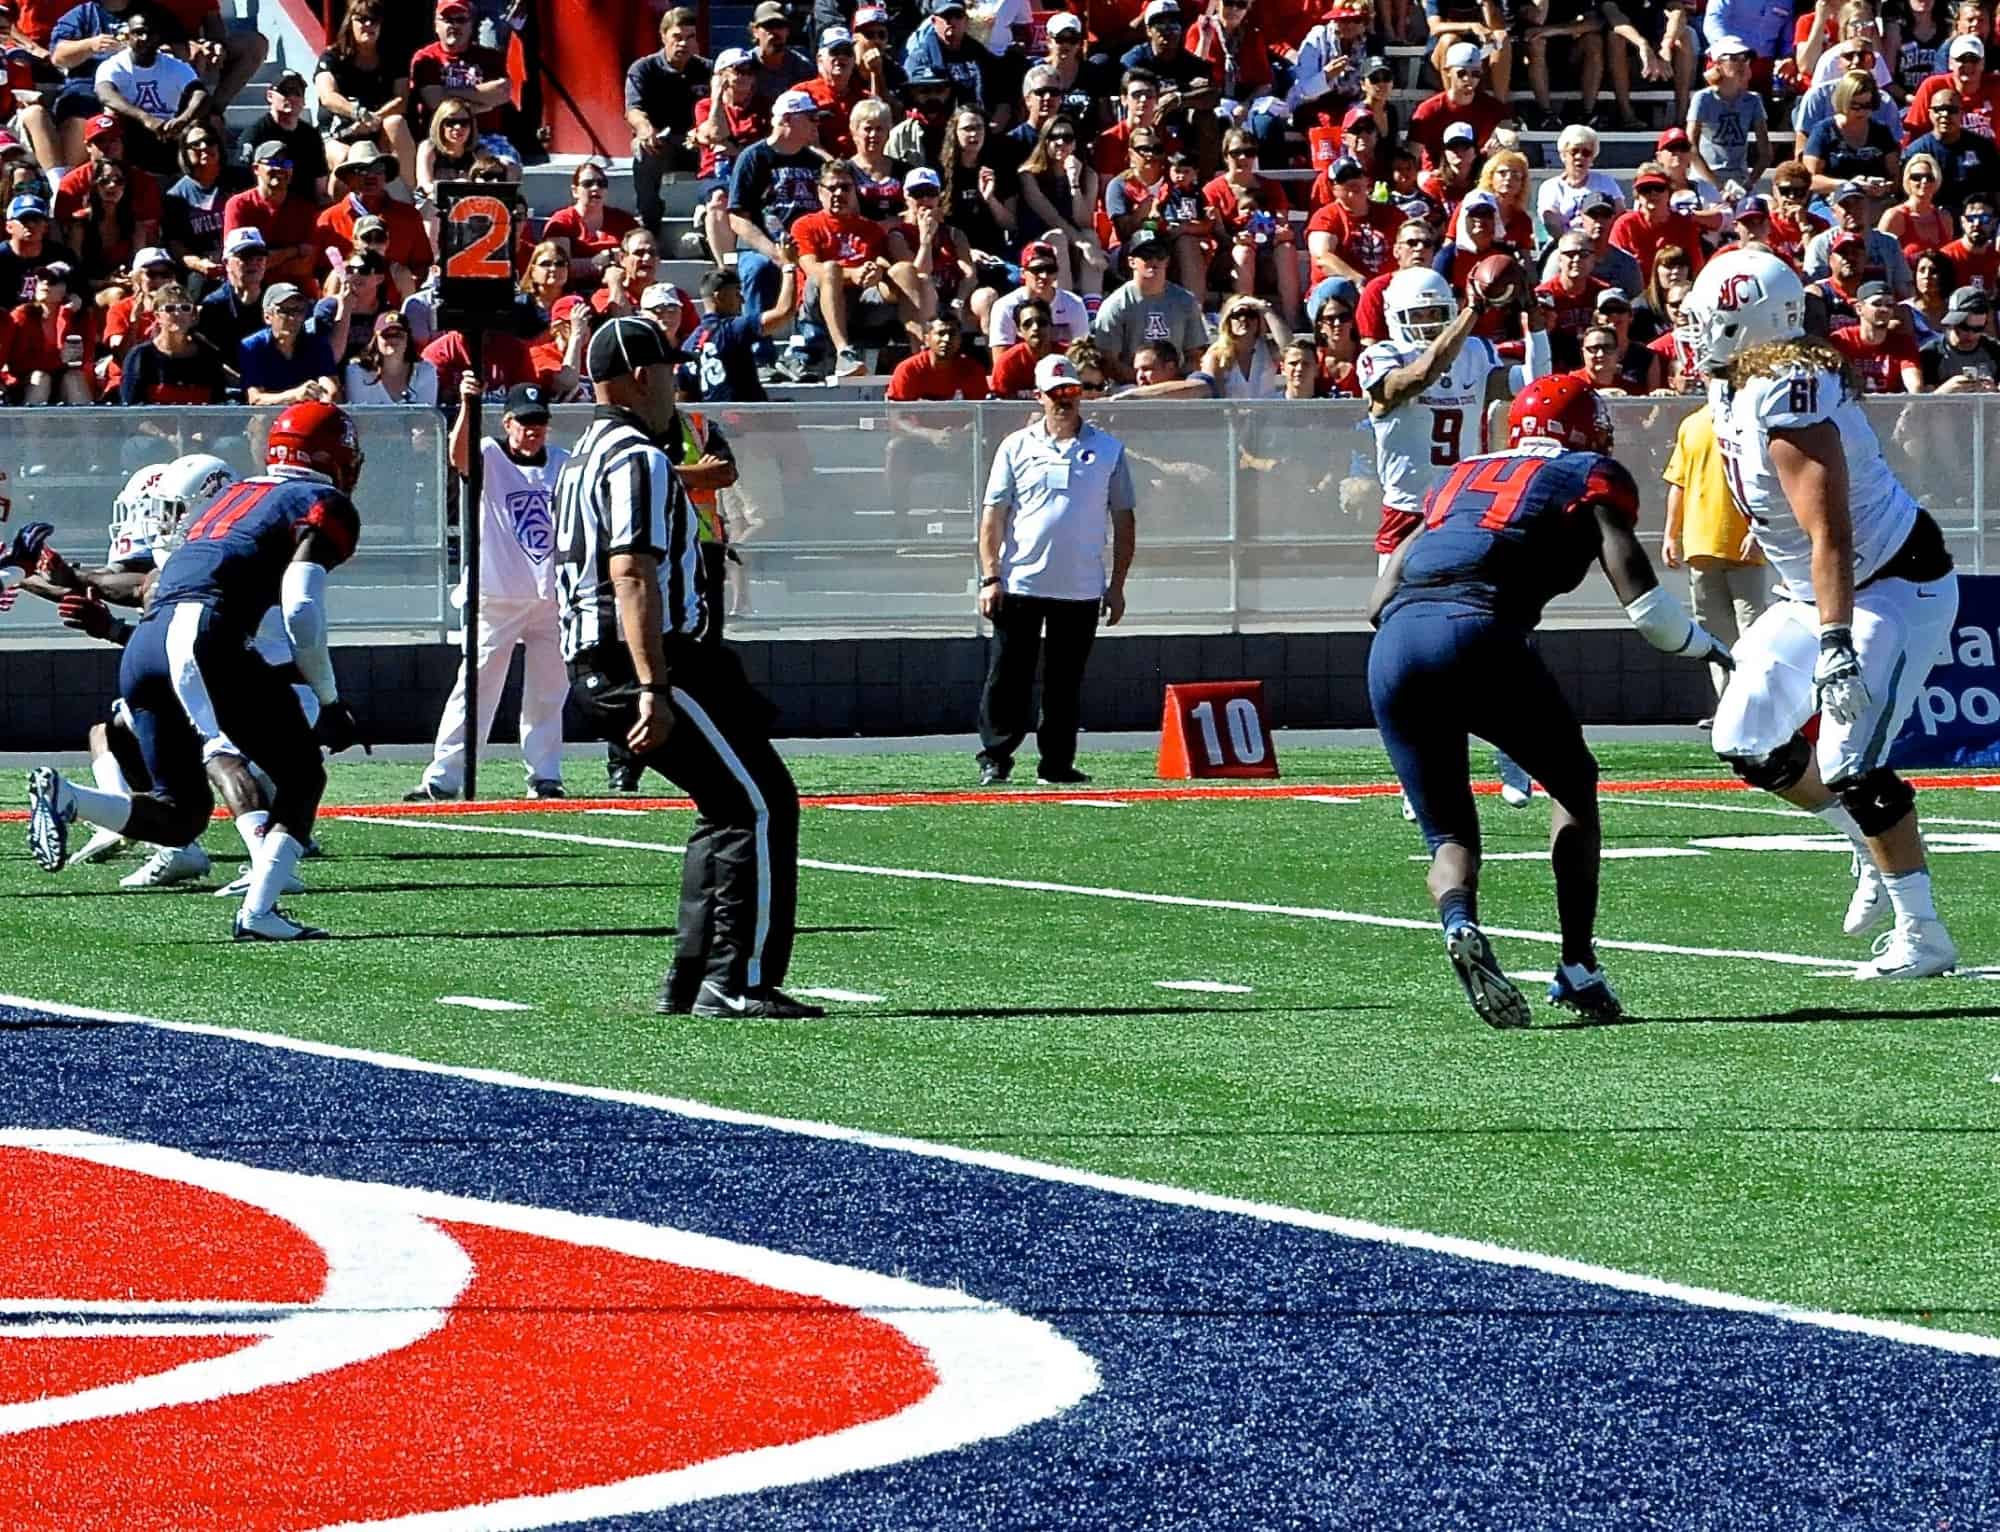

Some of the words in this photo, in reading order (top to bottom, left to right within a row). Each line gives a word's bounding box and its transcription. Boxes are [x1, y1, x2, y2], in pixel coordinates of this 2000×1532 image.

[135, 81, 169, 118] A
[1712, 112, 1745, 147] A
[447, 195, 511, 277] 2
[1143, 311, 1170, 340] A
[1788, 376, 1818, 413] 61
[1430, 408, 1464, 466] 9
[186, 481, 277, 541] 11
[1425, 457, 1546, 532] 14
[526, 530, 549, 549] 12
[1191, 698, 1265, 766] 10
[1906, 686, 2000, 736] po
